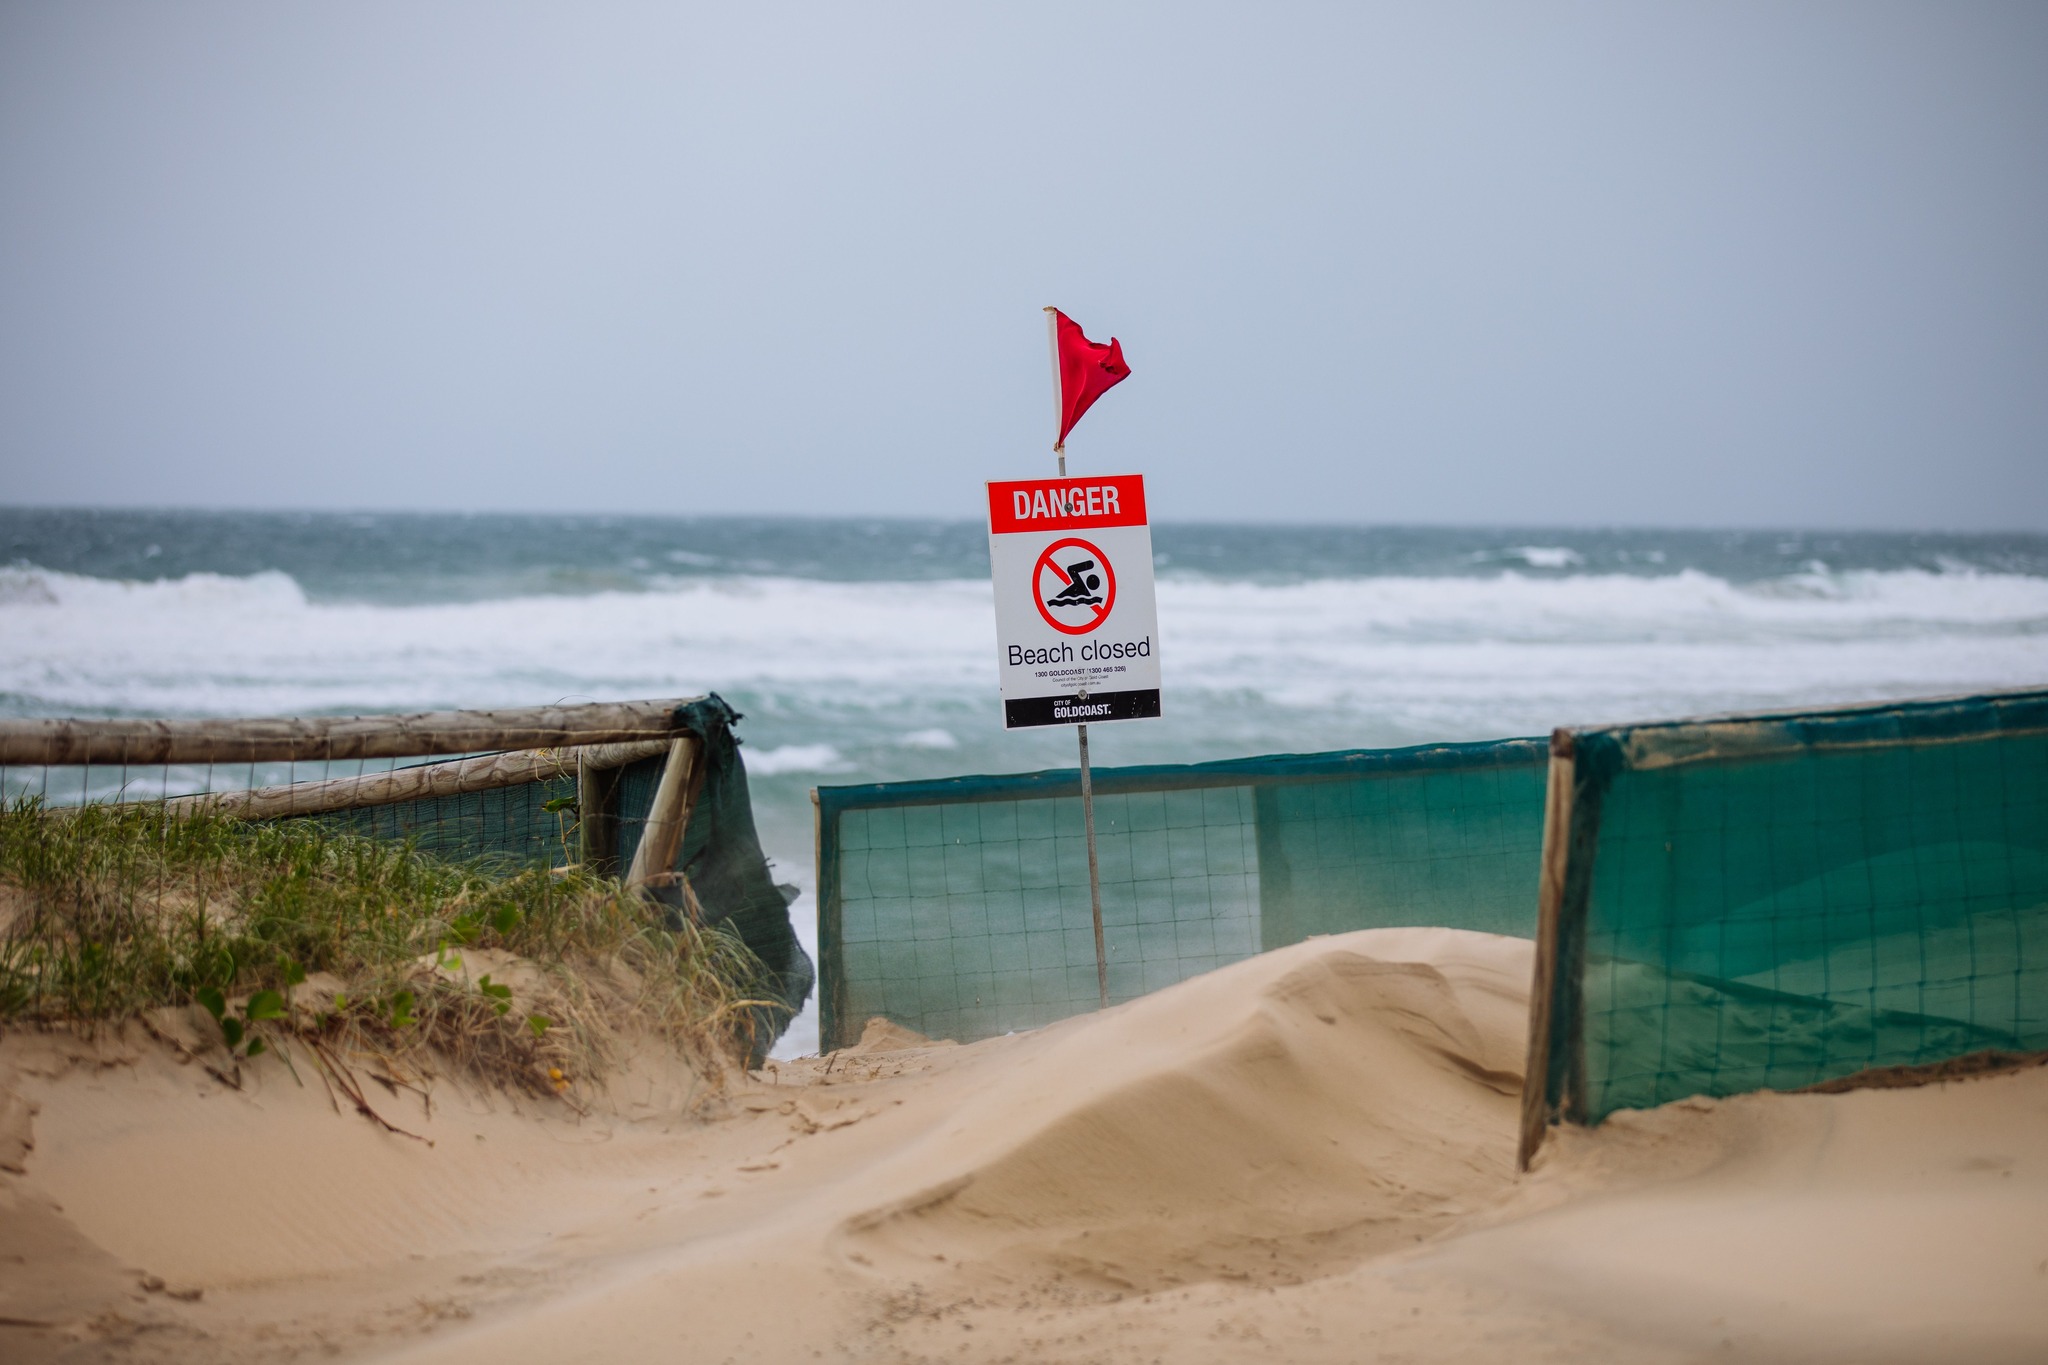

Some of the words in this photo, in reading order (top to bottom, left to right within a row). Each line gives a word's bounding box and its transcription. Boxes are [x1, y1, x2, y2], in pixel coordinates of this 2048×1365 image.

[1013, 486, 1121, 520] DANGER
[1008, 642, 1074, 666] Beach
[1081, 636, 1151, 661] closed
[1048, 668, 1085, 677] GOLDCOAST
